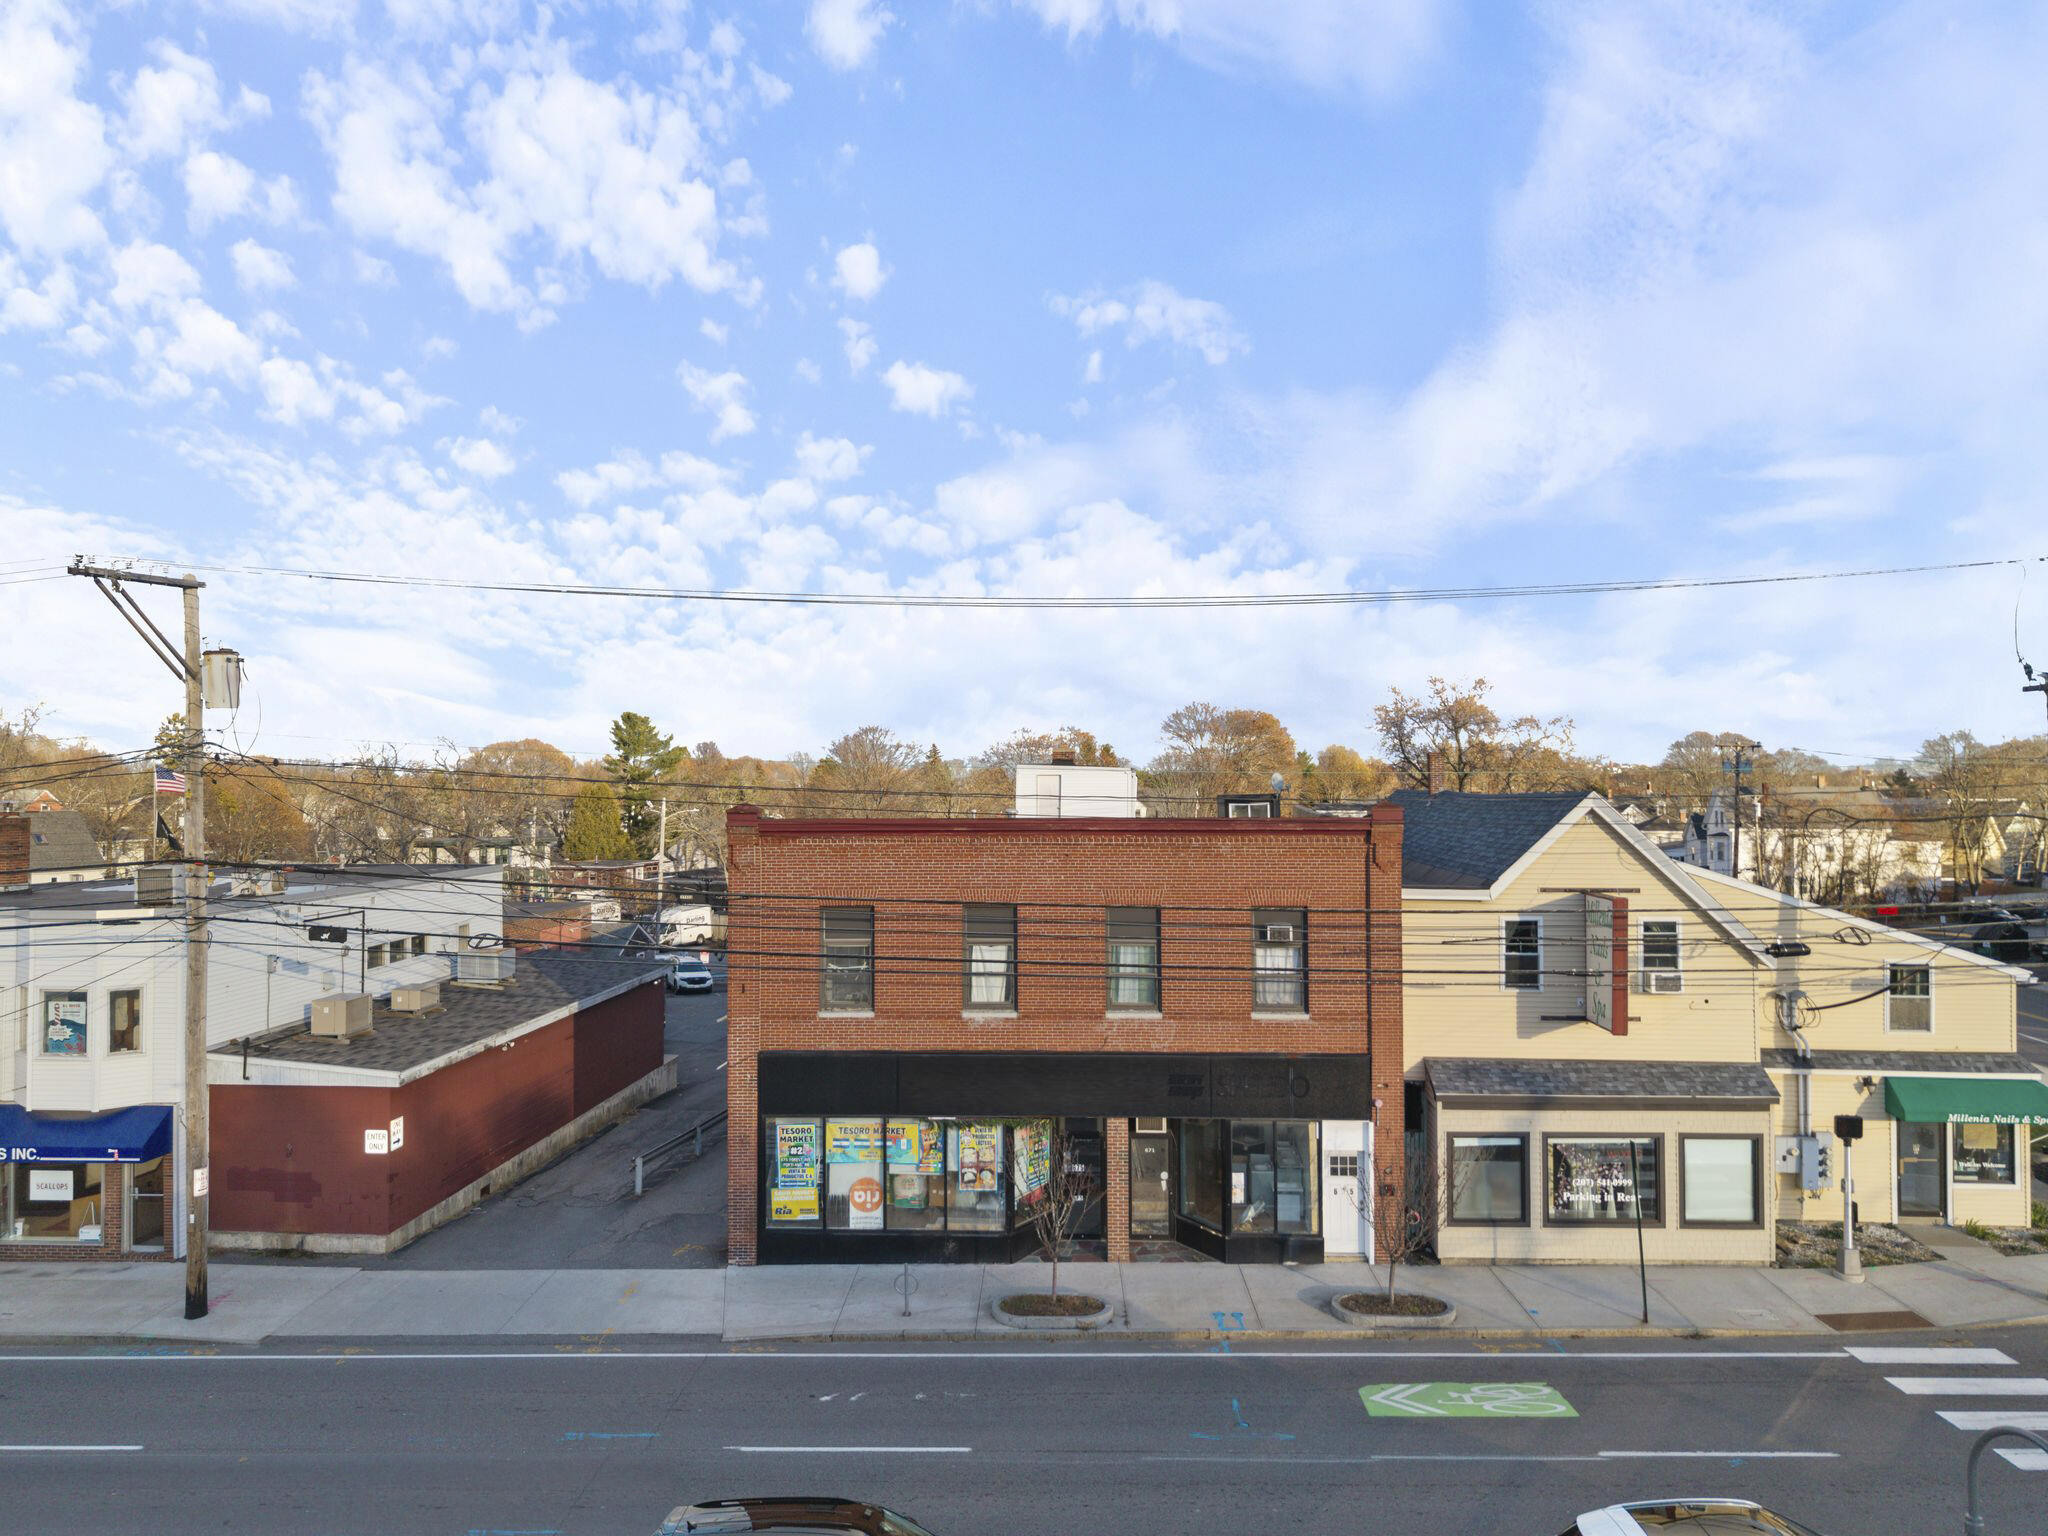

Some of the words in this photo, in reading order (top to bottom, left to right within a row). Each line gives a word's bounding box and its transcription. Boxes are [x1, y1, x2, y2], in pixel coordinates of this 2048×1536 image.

[1592, 991, 1606, 1024] Spa
[1947, 1113, 1990, 1123] Millenia
[1992, 1114, 2020, 1124] Nails
[2022, 1115, 2031, 1124] &
[781, 1127, 812, 1135] TESORO
[838, 1127, 870, 1135] TESORO
[780, 1135, 814, 1143] MARKET
[369, 1142, 384, 1150] ONLY
[790, 1146, 803, 1155] #2
[11, 1147, 40, 1160] INC.
[36, 1183, 68, 1191] SCALLOPS
[1572, 1178, 1594, 1188] (207)
[1563, 1192, 1602, 1204] Parking
[775, 1205, 792, 1215] Ria
